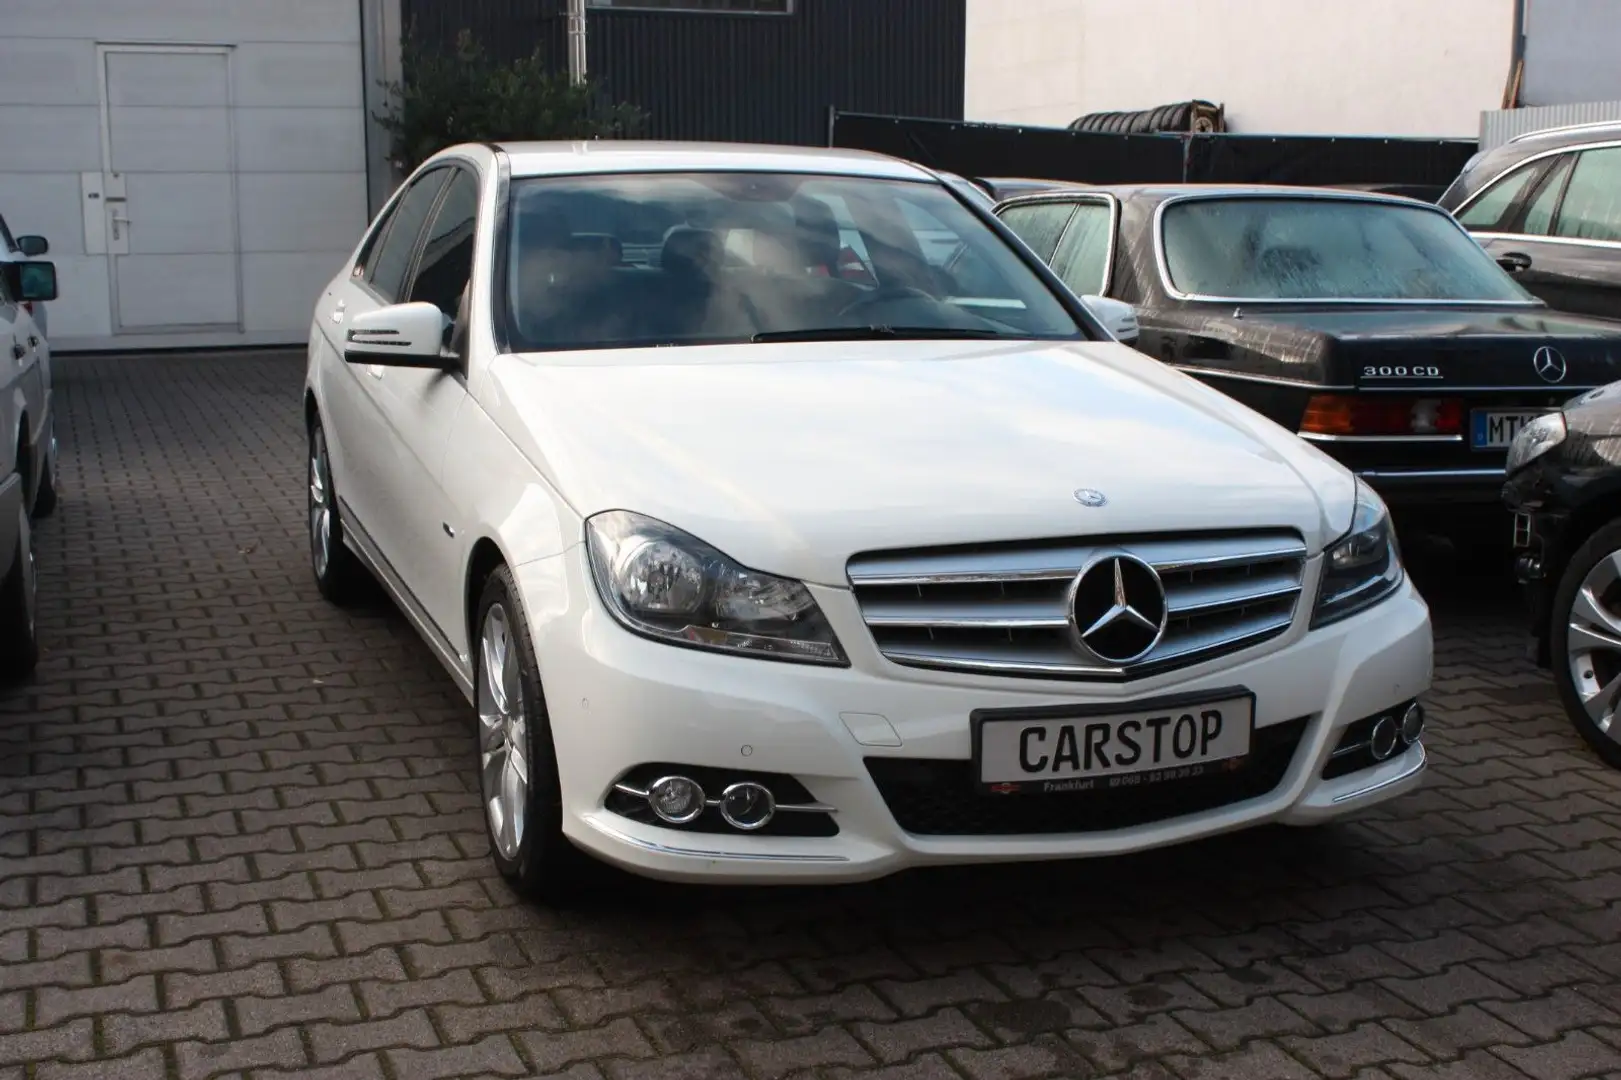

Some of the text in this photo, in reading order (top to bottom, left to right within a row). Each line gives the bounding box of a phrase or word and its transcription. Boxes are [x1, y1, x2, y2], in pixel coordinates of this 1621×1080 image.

[1363, 365, 1439, 376] 300 CD
[1489, 415, 1534, 442] MT
[1019, 709, 1223, 773] CARSTOP
[1043, 779, 1094, 793] Frankfurt
